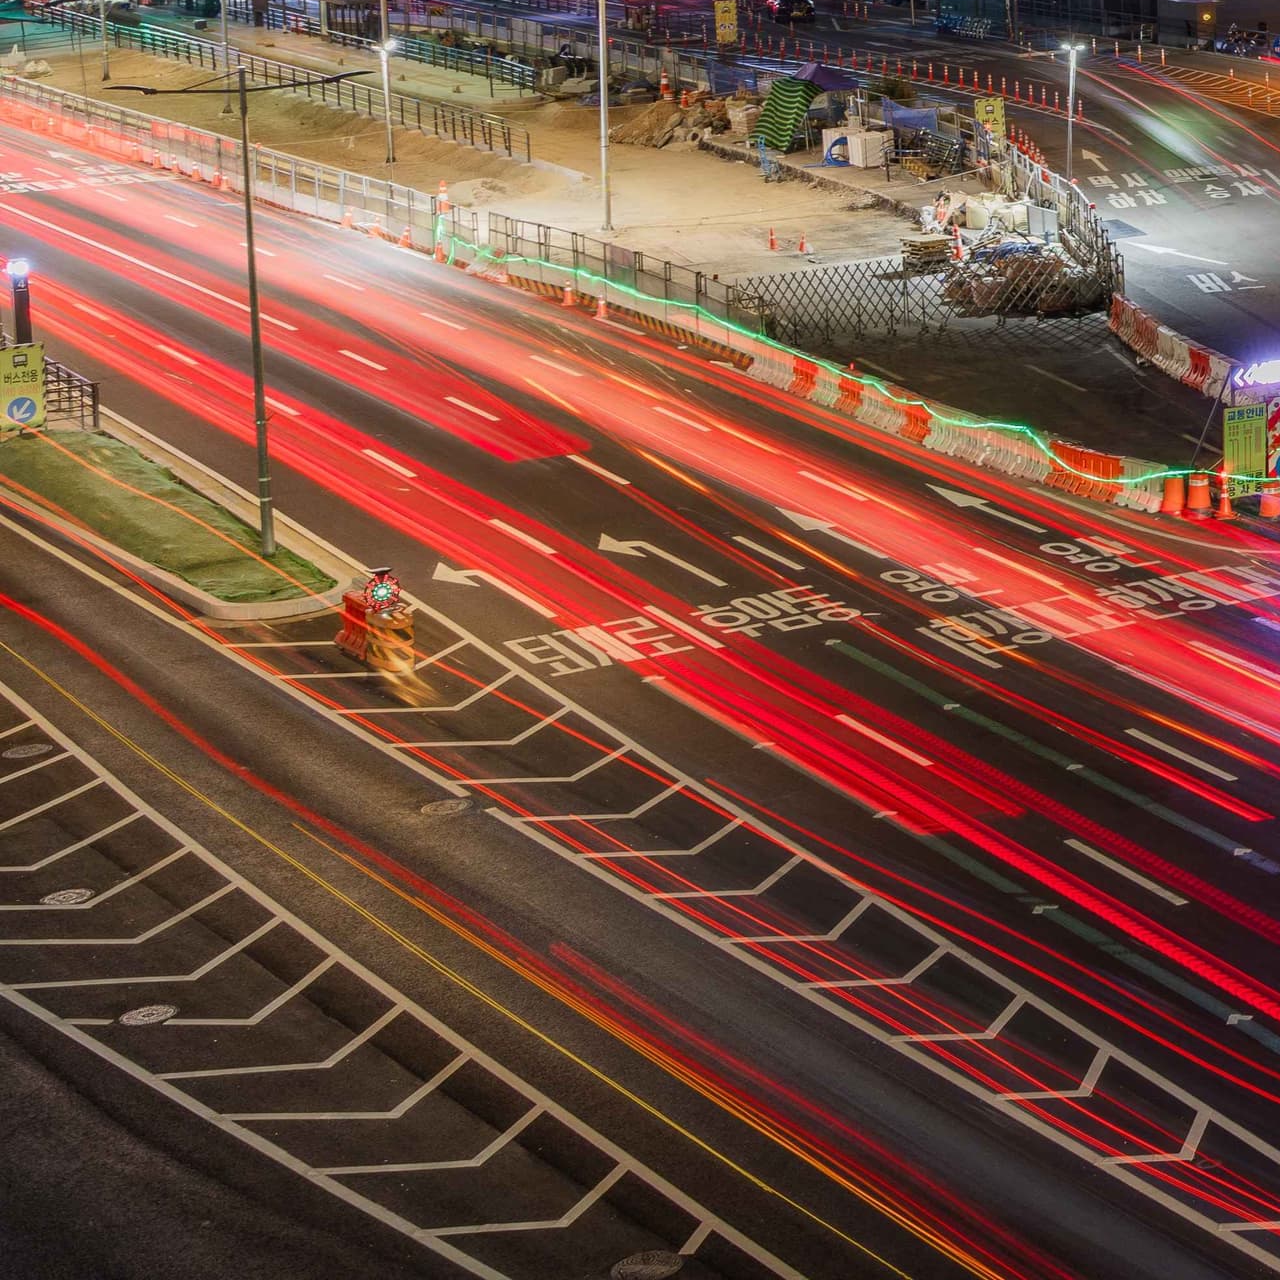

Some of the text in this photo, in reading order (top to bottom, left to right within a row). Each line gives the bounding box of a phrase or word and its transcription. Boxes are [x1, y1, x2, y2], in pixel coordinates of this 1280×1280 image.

[1087, 171, 1150, 190] 택시
[1204, 180, 1268, 200] 승차
[1105, 188, 1169, 210] 하차
[17, 279, 26, 289] 4
[1186, 271, 1267, 294] 버스
[3, 369, 39, 385] 버스전용
[1227, 406, 1265, 422] 교통안내
[1037, 535, 1162, 574] 용산
[879, 561, 1004, 604] 용산
[689, 585, 865, 639] 후암동
[503, 614, 695, 678] 퇴계로
